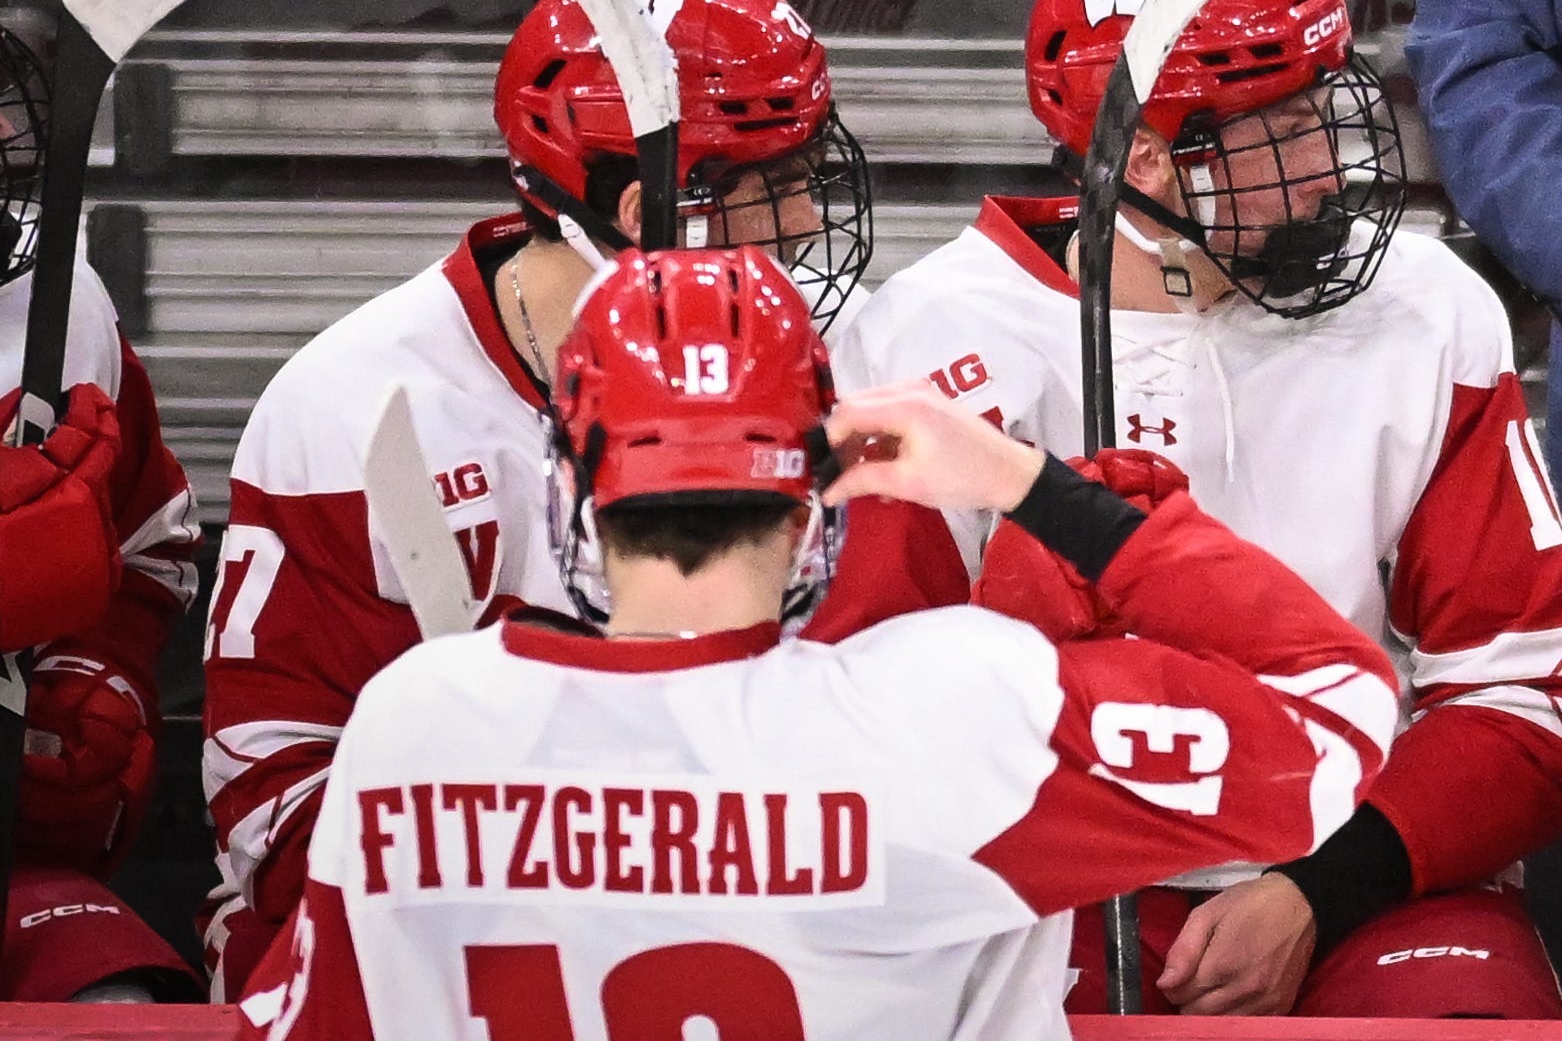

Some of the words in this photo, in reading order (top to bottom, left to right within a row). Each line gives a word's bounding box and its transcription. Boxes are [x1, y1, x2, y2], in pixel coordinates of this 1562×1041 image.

[1303, 8, 1345, 45] CCM
[682, 343, 729, 395] 13
[358, 782, 869, 896] FITZGERALD
[19, 901, 121, 929] CCM
[1376, 946, 1491, 968] CCM
